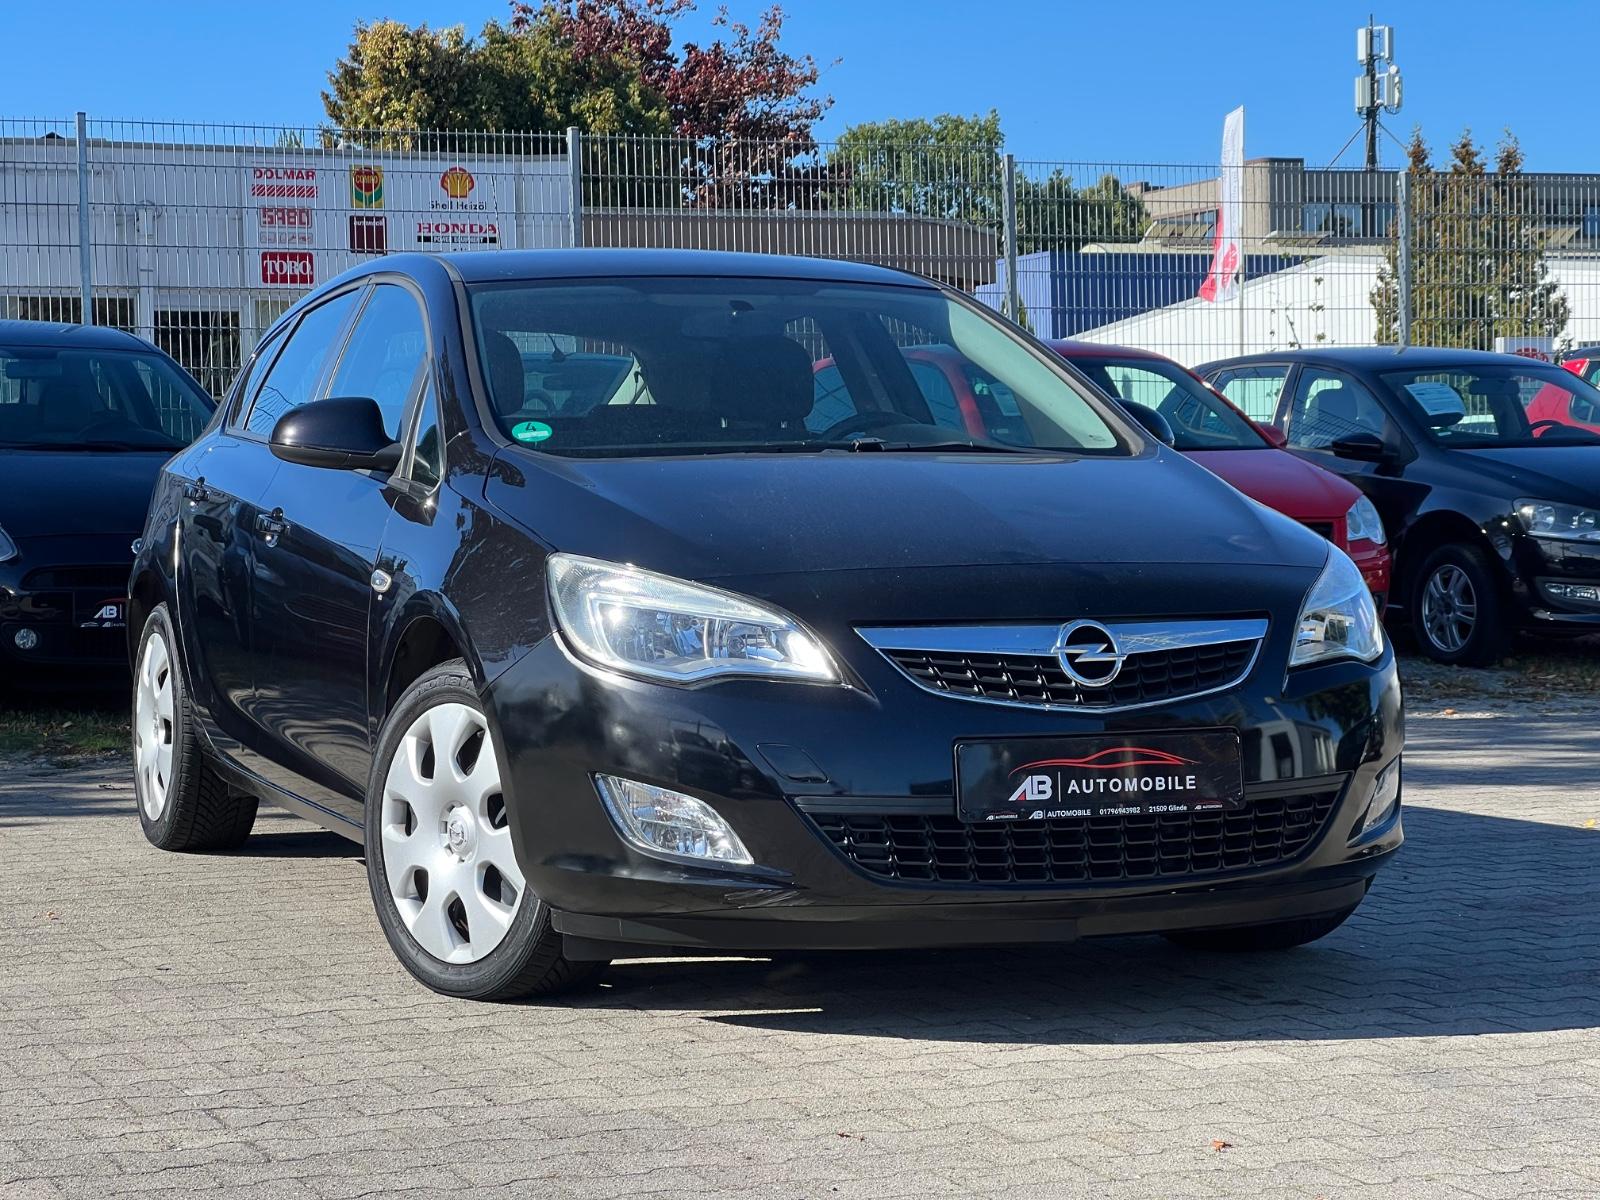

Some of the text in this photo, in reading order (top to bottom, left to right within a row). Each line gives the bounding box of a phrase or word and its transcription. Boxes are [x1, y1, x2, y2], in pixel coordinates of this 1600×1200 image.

[253, 168, 316, 180] DOLMAR
[355, 174, 379, 184] COMPO
[429, 200, 487, 210] Shell Heizöl
[262, 208, 310, 225] SABO
[417, 222, 497, 234] HONDA
[93, 605, 117, 619] AB
[1008, 775, 1197, 801] AB AUTOMOBILE
[1028, 810, 1044, 820] AB
[1047, 809, 1092, 818] AUTOMOBILE
[1148, 805, 1168, 813] 21509
[1168, 804, 1188, 812] Glinde
